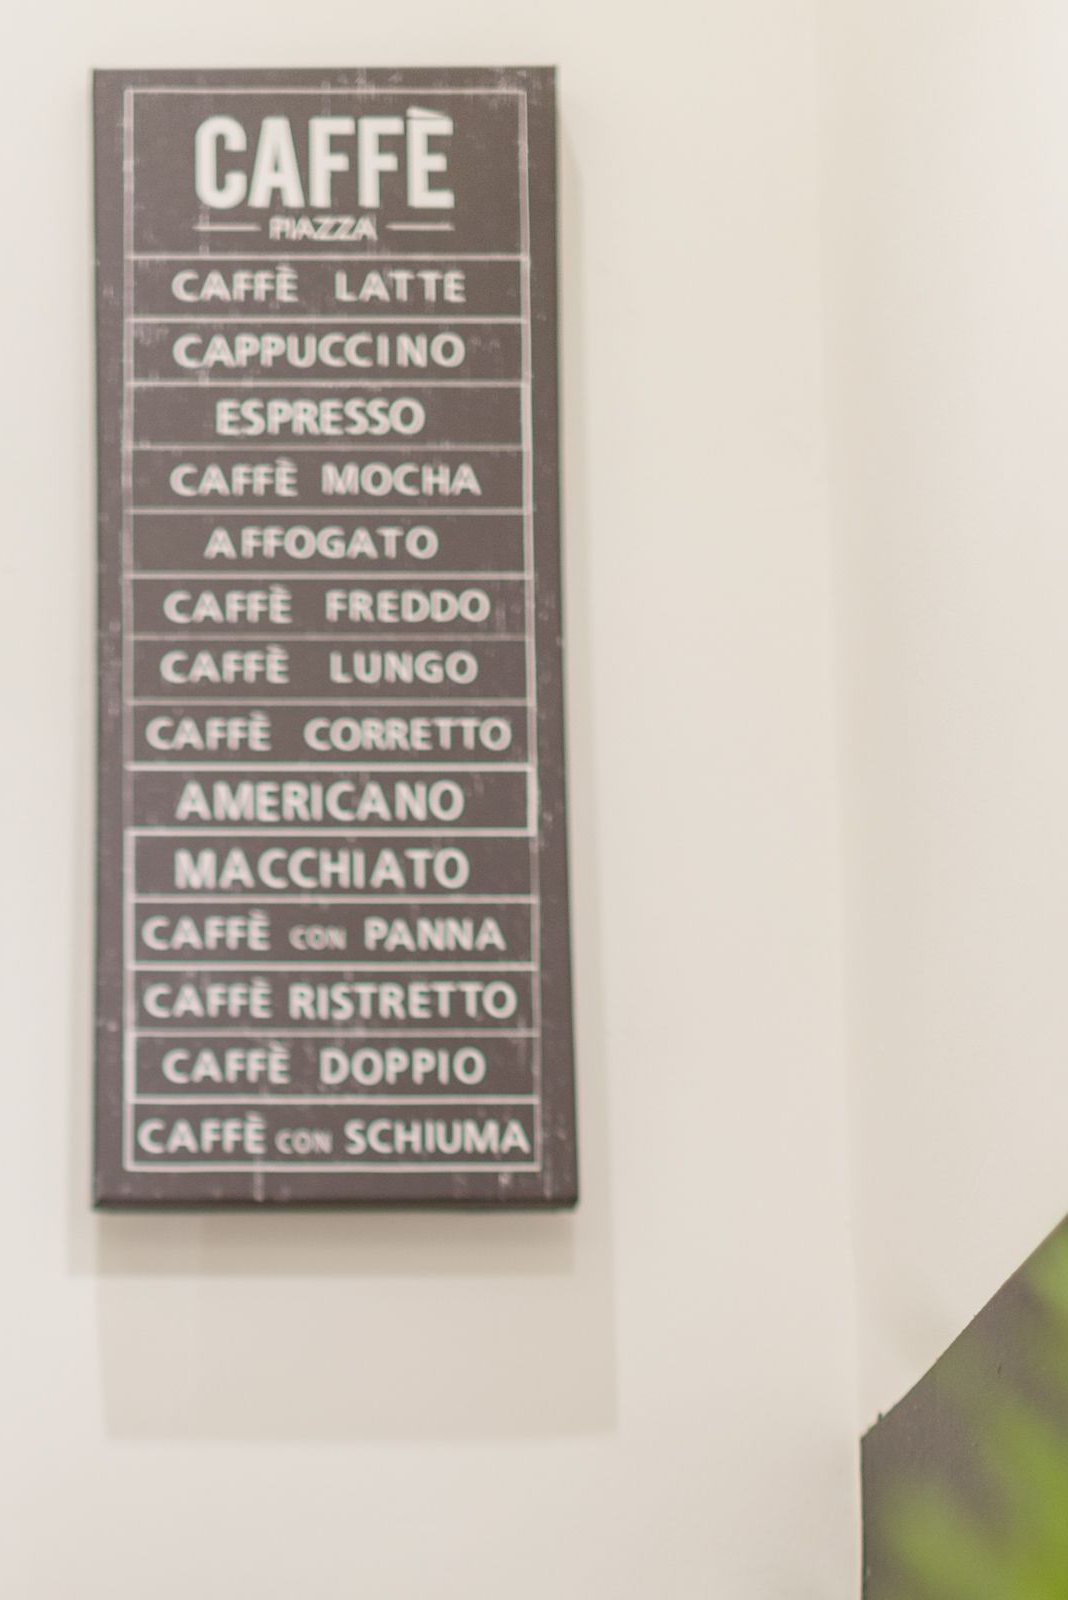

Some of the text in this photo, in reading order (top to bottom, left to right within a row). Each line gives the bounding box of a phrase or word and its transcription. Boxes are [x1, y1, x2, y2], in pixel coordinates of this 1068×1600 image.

[194, 107, 455, 210] CAFFÈ
[269, 215, 378, 241] PIAZZA
[170, 266, 466, 303] CAFFÈ LATTE
[172, 333, 466, 368] CAPPUCCINO
[215, 397, 425, 436] ESPRESSO
[170, 457, 482, 497] CAFFÈ MOCHA
[204, 526, 439, 560] AFFOGATO
[163, 586, 491, 624] CAFFÈ FREDDO
[159, 645, 478, 685] CAFFÈ LUNGO
[145, 712, 513, 751] CAFFÈ CORRETTO
[175, 779, 465, 821] AMERICANO
[173, 848, 470, 890] MACCHIATO
[141, 911, 506, 952] CAFFÈ CON PANNA
[143, 979, 517, 1019] CAFFÈ RISTRETTO
[161, 1045, 487, 1085] CAFFÈ DOPPIO
[137, 1113, 530, 1154] CAFFÈ CON SCHIUMA
